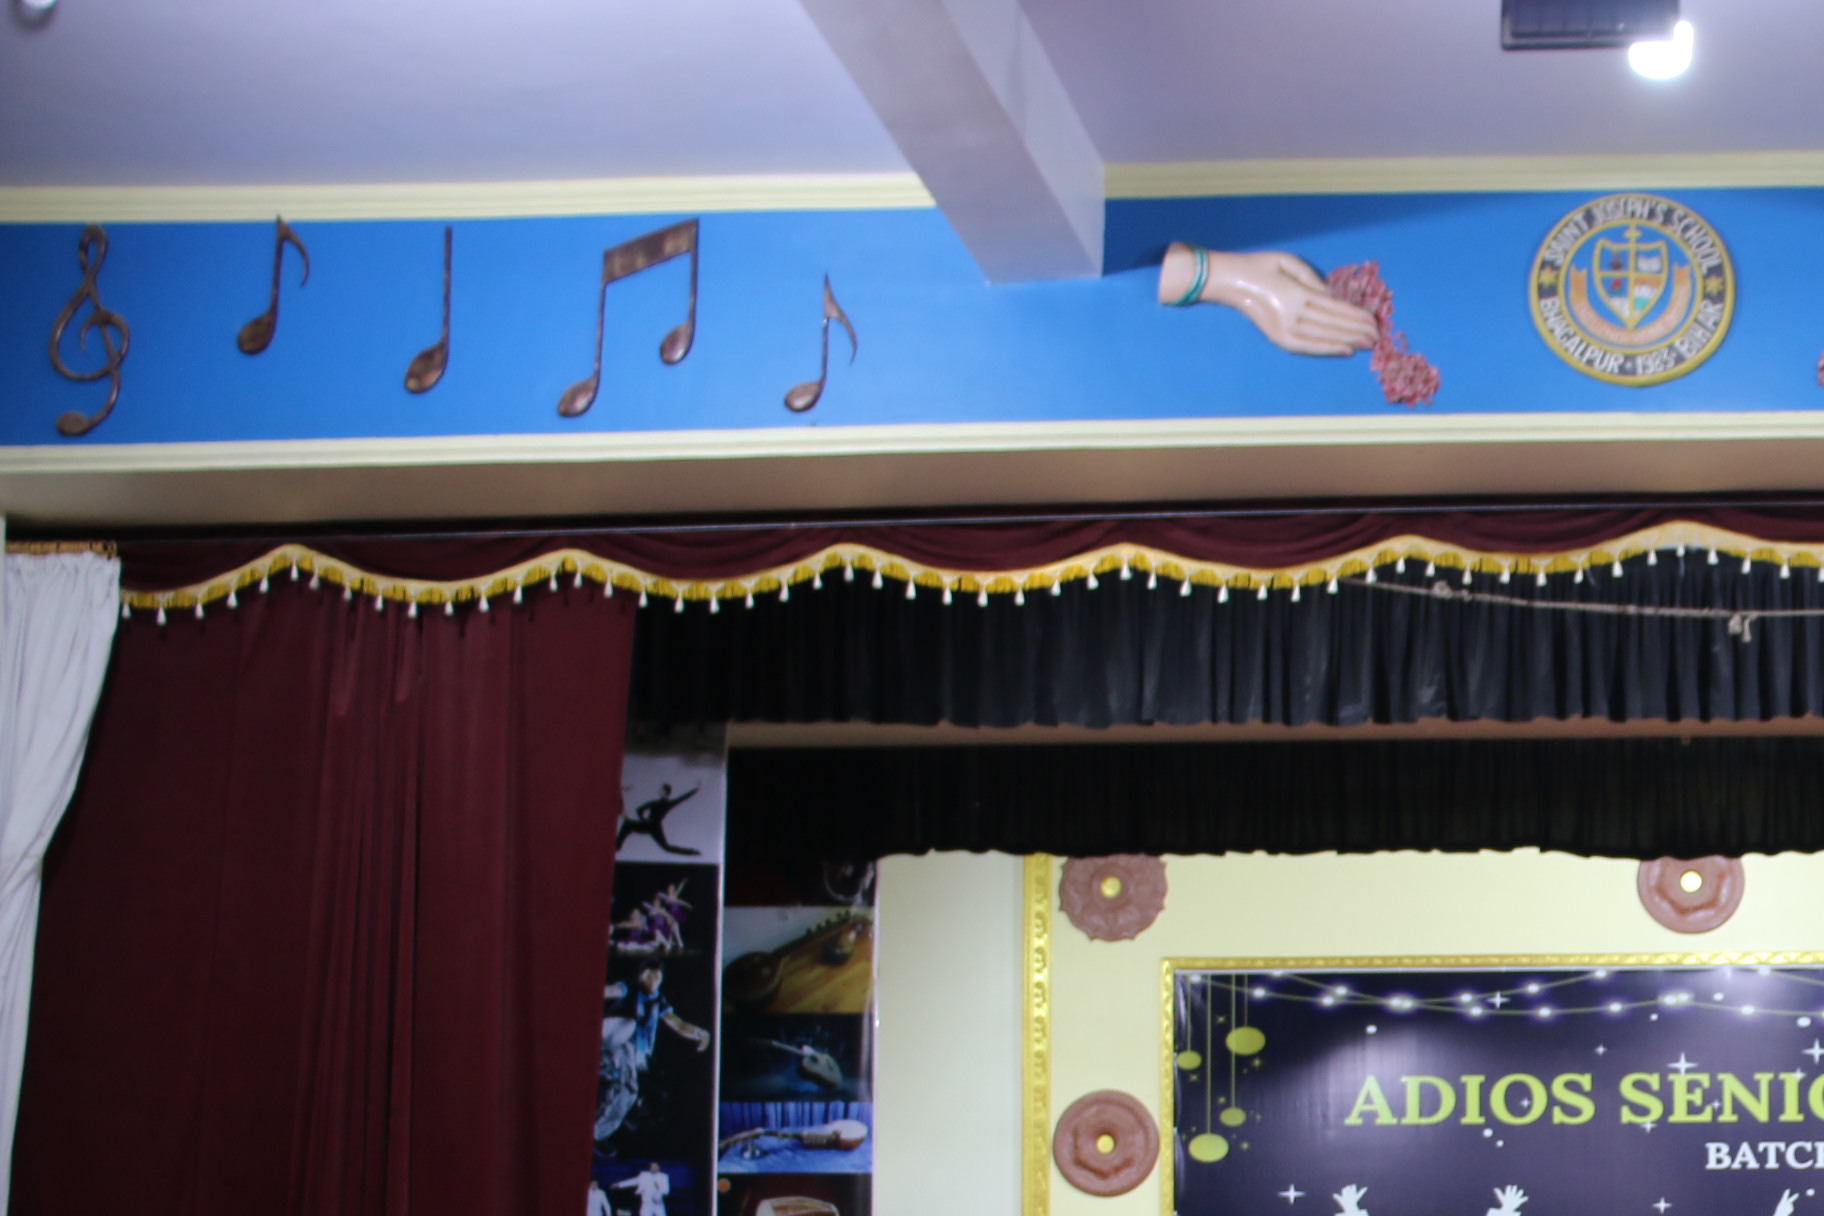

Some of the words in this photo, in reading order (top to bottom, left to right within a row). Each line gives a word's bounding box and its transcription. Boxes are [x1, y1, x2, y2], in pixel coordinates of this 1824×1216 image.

[1544, 211, 1589, 267] SAINT
[1590, 198, 1668, 227] JOSEPH'S
[1671, 209, 1721, 276] SCHOOL
[1540, 297, 1625, 374] BHAGALPUR
[1674, 299, 1723, 359] BIHAR
[1344, 1073, 1596, 1126] ADIOS
